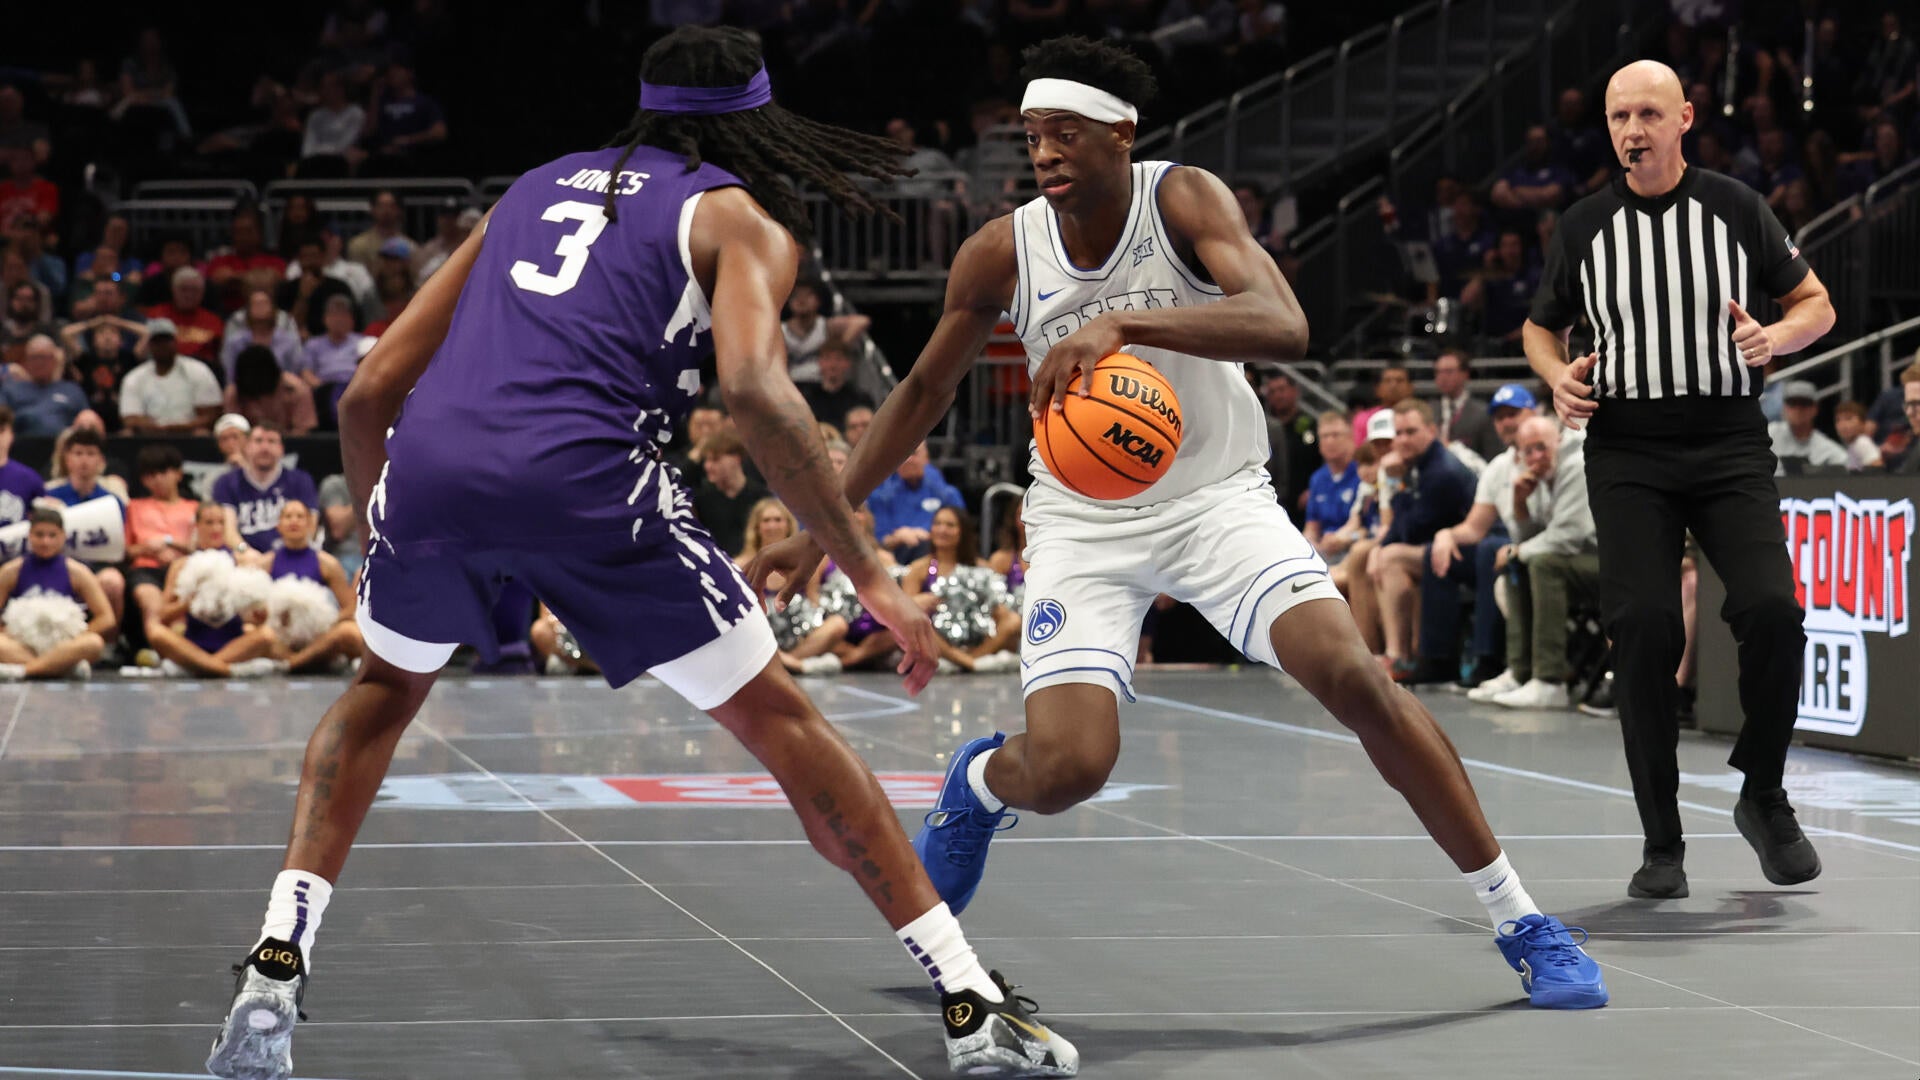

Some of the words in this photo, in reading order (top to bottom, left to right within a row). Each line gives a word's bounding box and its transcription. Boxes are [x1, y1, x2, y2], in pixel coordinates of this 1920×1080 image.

[556, 168, 651, 196] JONES
[510, 200, 609, 297] 3
[1109, 373, 1182, 438] Wilson
[1103, 422, 1165, 468] NCAA
[1780, 505, 1907, 627] COUNT
[1800, 643, 1851, 711] RE
[259, 948, 299, 970] GiGi
